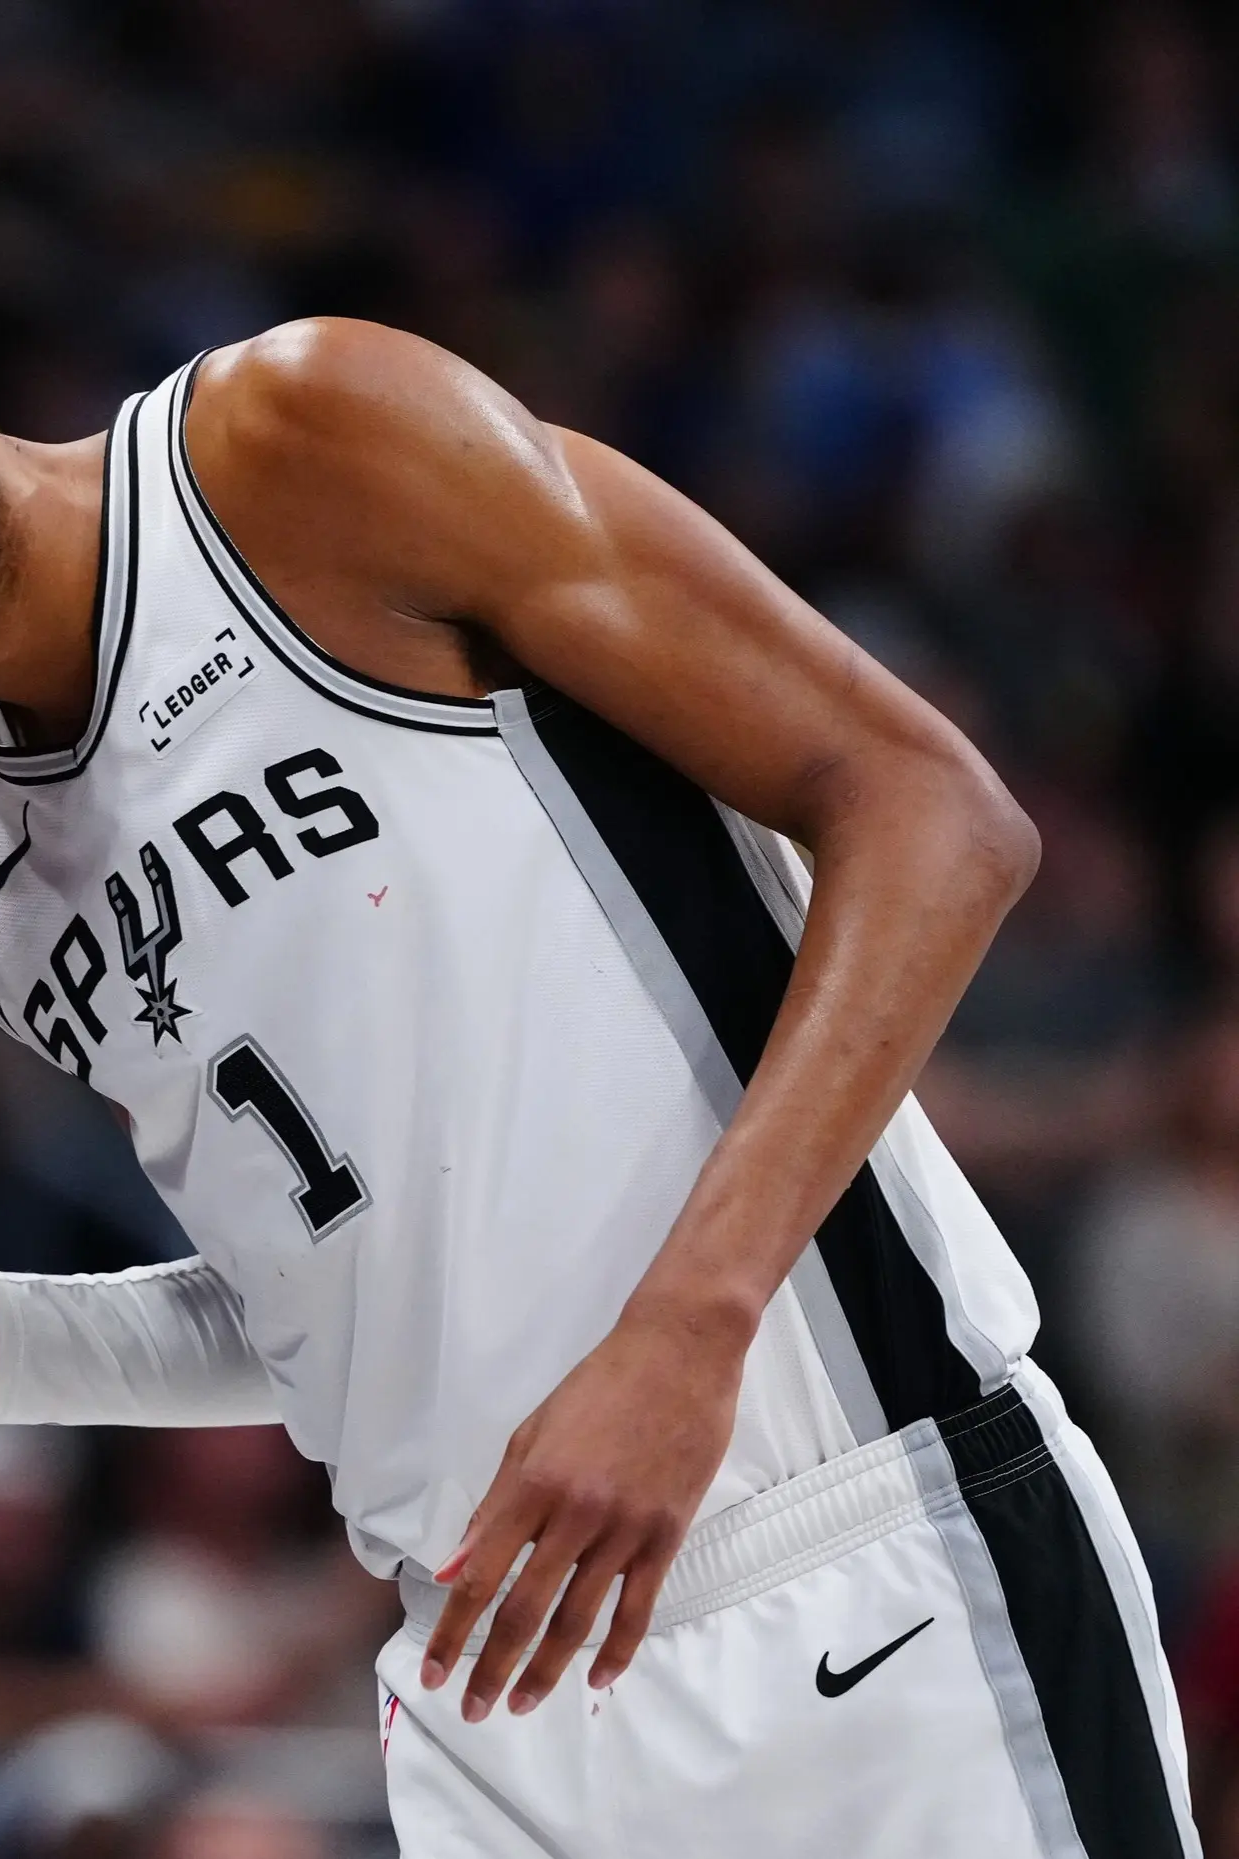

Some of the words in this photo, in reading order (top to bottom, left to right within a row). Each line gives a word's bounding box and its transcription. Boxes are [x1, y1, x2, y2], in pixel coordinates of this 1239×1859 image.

[153, 652, 233, 729] LEDGER
[24, 748, 379, 1083] SPURS
[207, 1033, 373, 1244] 1
